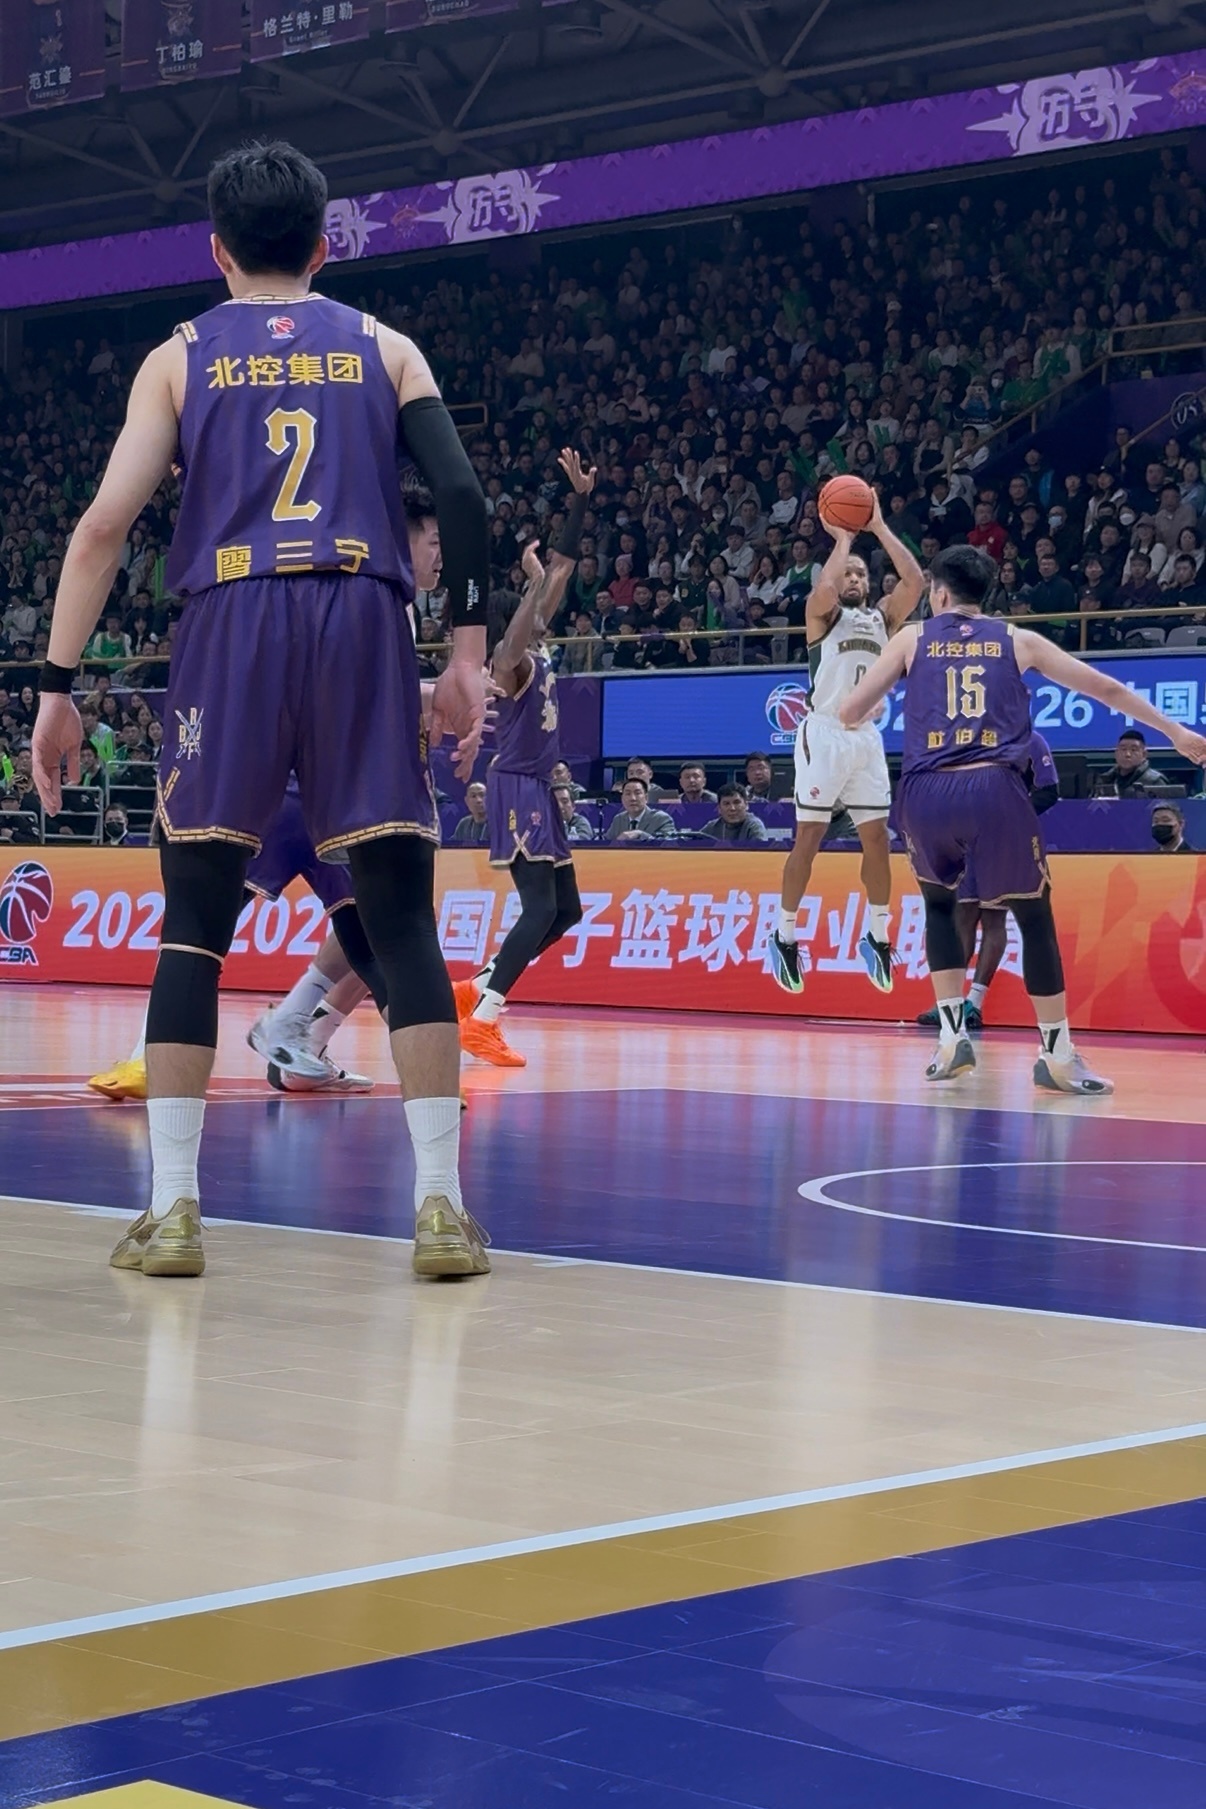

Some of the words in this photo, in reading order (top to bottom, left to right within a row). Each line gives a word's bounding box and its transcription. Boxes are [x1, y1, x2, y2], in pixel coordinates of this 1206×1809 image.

[263, 1, 353, 38] 格兰特·里勒
[206, 352, 363, 389] 北控集团
[264, 407, 322, 522] 2
[216, 538, 370, 583] 廖三宁
[926, 641, 1002, 658] 北控集团
[945, 664, 987, 720] 15
